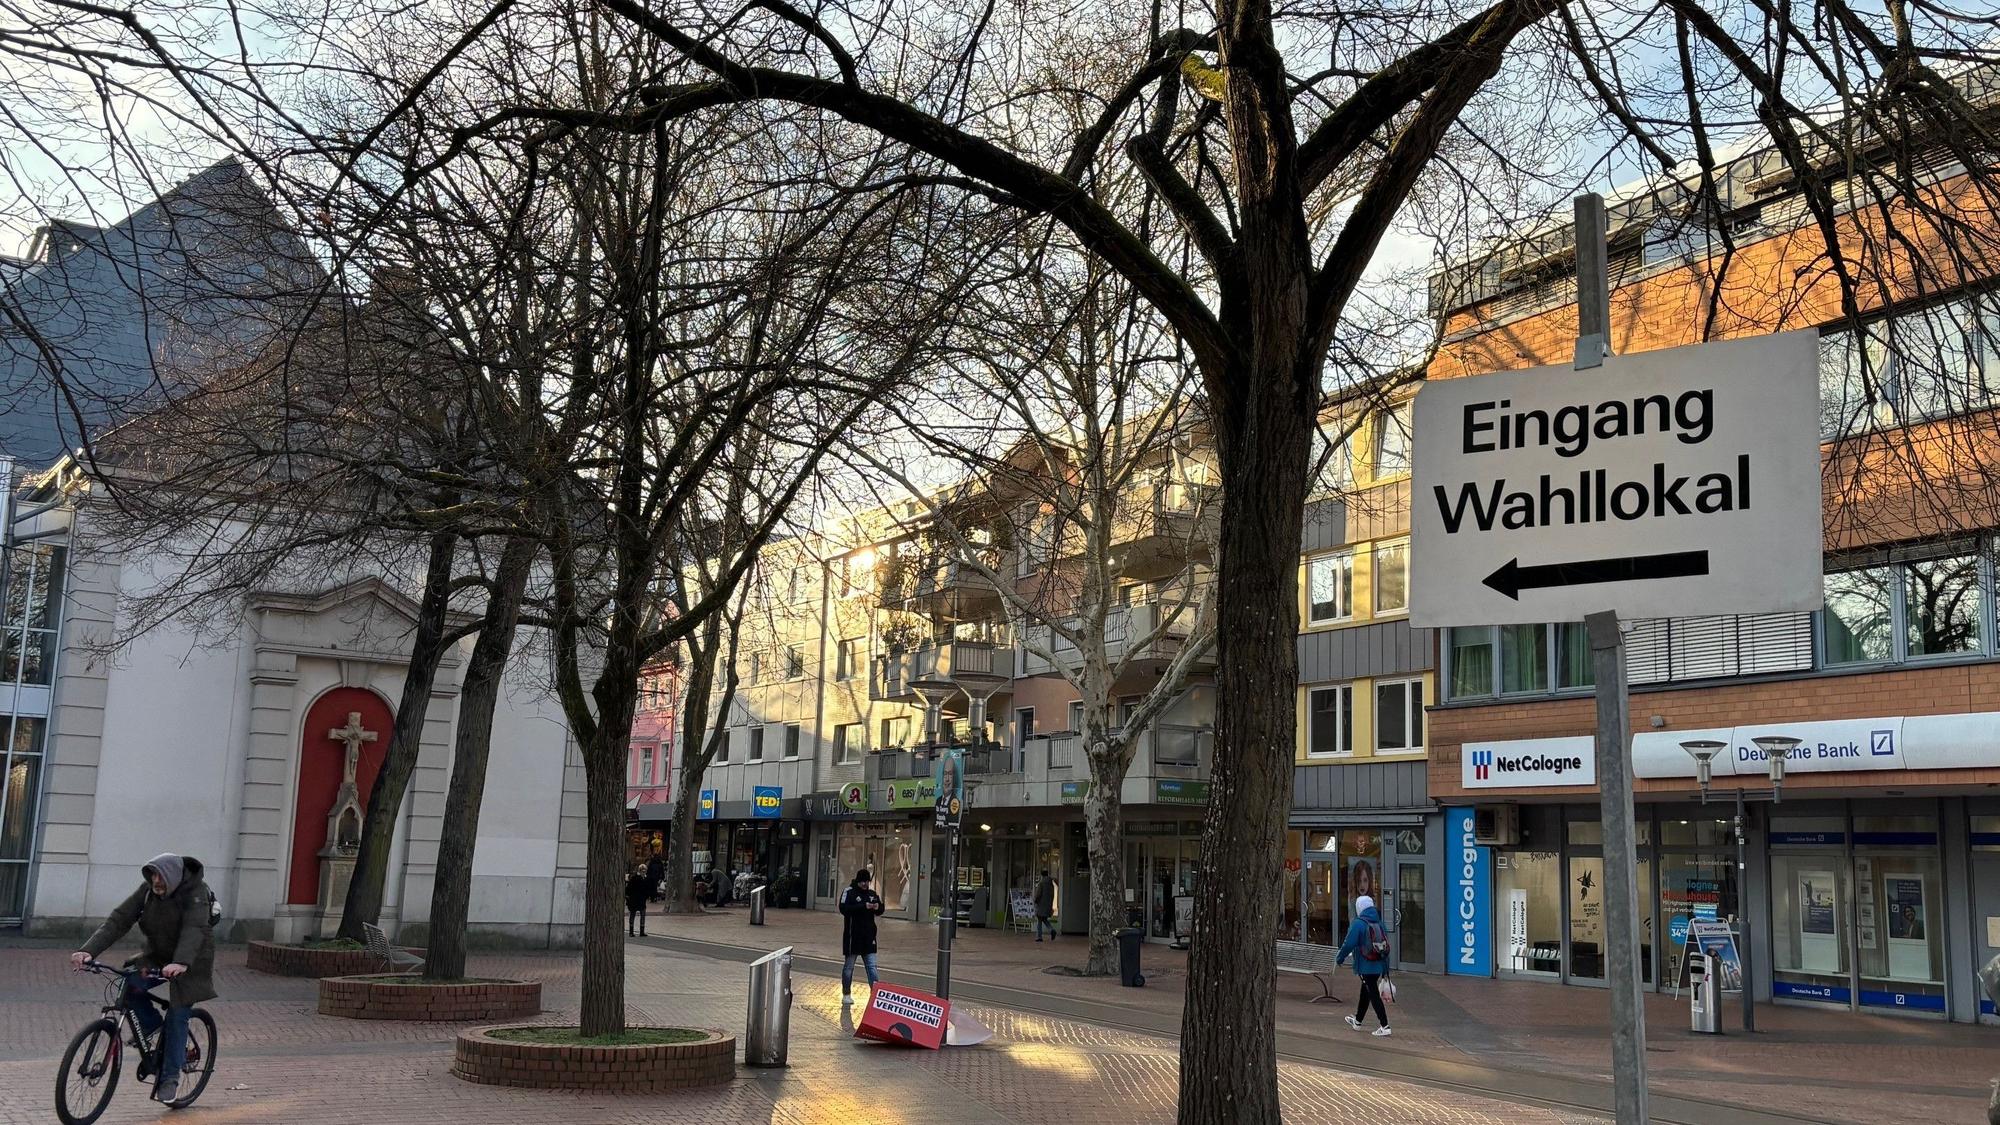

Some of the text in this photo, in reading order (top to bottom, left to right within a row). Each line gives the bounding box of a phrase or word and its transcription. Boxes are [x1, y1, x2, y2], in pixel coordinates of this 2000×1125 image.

[1462, 388, 1715, 458] Eingang
[1433, 453, 1751, 534] Wahllokal
[1496, 754, 1581, 774] NetCologne
[1738, 742, 1860, 761] Deuche Bank
[755, 796, 781, 807] TEDi
[1460, 817, 1477, 965] NetCologne
[875, 1001, 940, 1027] VERTEIDIGEN!
[878, 990, 943, 1015] DEMOKRATIE
